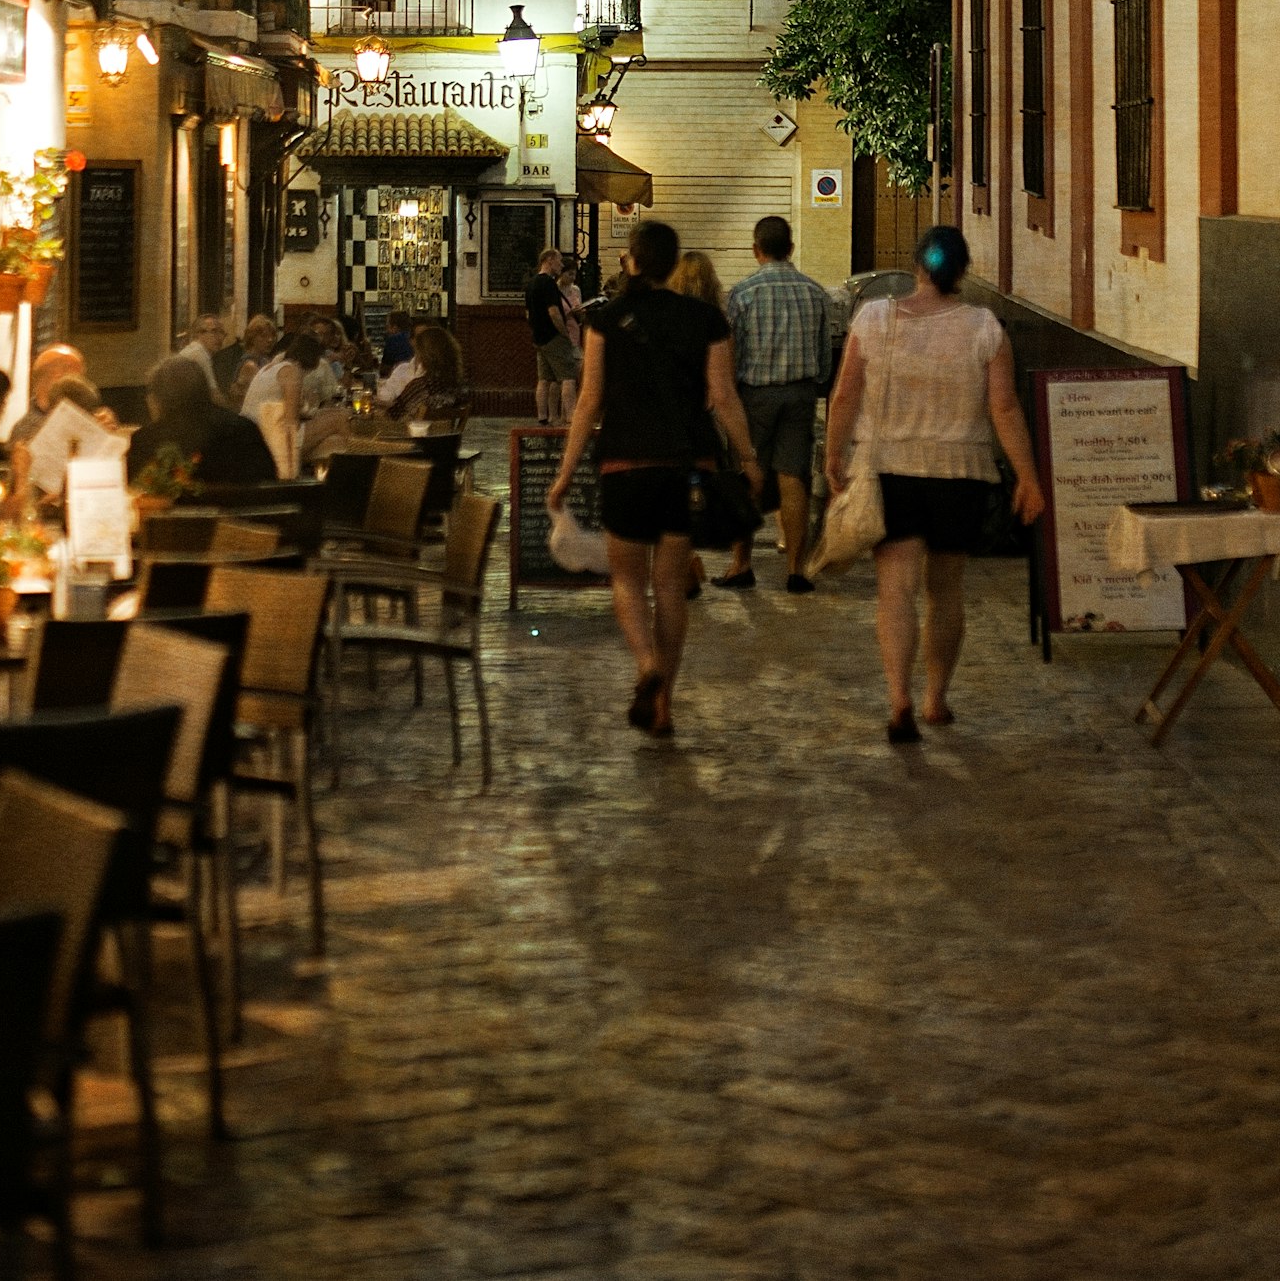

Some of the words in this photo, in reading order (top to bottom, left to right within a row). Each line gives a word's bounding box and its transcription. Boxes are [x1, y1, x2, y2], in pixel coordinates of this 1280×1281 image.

[323, 69, 516, 111] Restaurante
[522, 165, 550, 176] BAR
[1060, 408, 1074, 418] do
[1075, 410, 1095, 420] you
[1097, 408, 1122, 417] want
[1124, 407, 1136, 416] to
[1073, 437, 1115, 449] Healthy
[1056, 475, 1089, 488] Single
[1090, 475, 1113, 485] dish
[1114, 474, 1140, 484] meal
